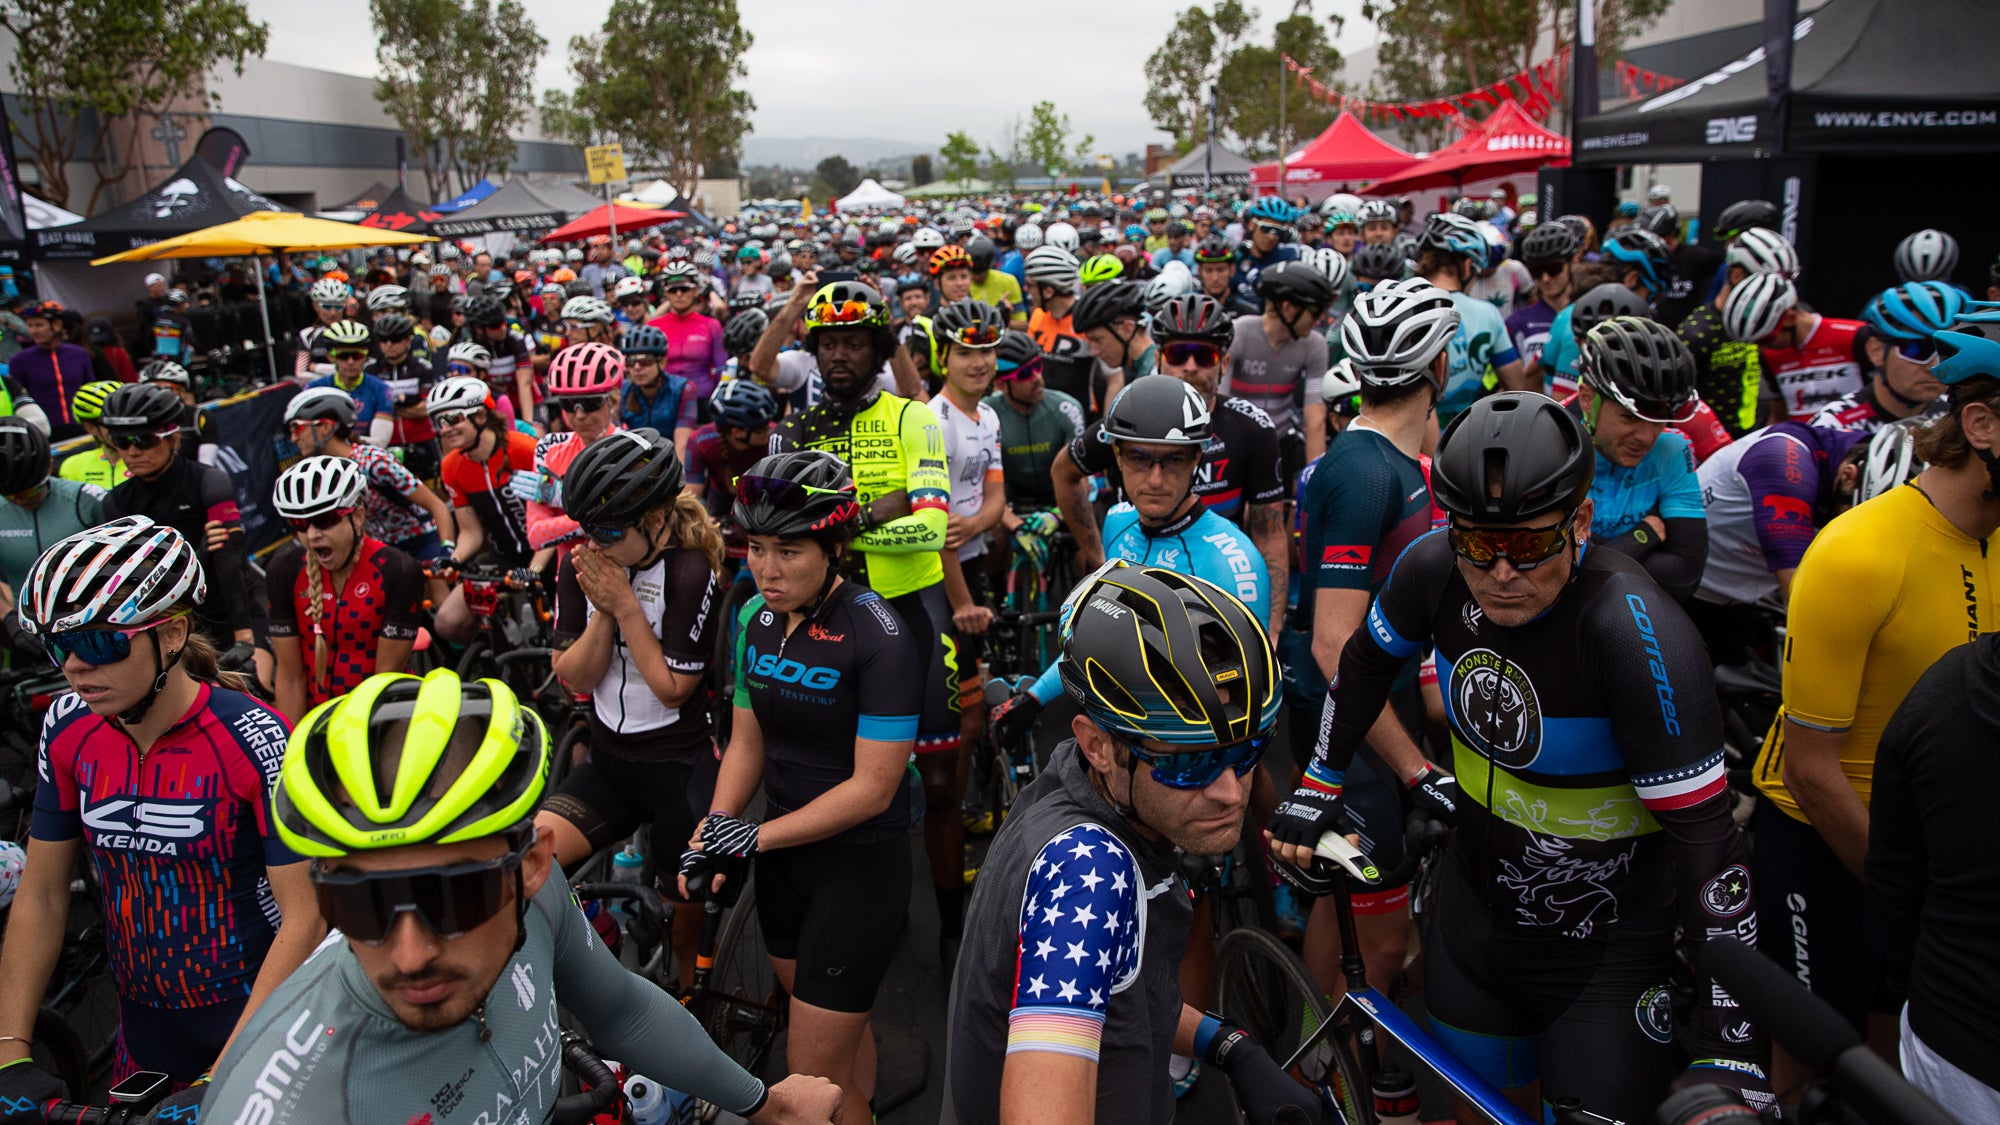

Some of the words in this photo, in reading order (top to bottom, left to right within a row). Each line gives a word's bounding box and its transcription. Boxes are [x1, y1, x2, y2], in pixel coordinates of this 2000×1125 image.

[1814, 111, 1998, 128] WWW.ENVE.COM
[1779, 366, 1850, 384] TREK
[855, 419, 888, 433] ELIEL
[1320, 563, 1368, 571] DONNELLY
[1089, 598, 1127, 620] MAVIC
[1960, 564, 1980, 643] GIANT
[868, 601, 896, 633] HYDRO
[753, 653, 842, 690] SDG
[779, 687, 836, 705] TESTCORP
[96, 833, 178, 857] KENDA
[232, 1008, 326, 1125] BMC
[430, 1082, 452, 1105] UCI
[436, 1067, 476, 1112] AMERICA
[440, 1091, 466, 1118] TOUR
